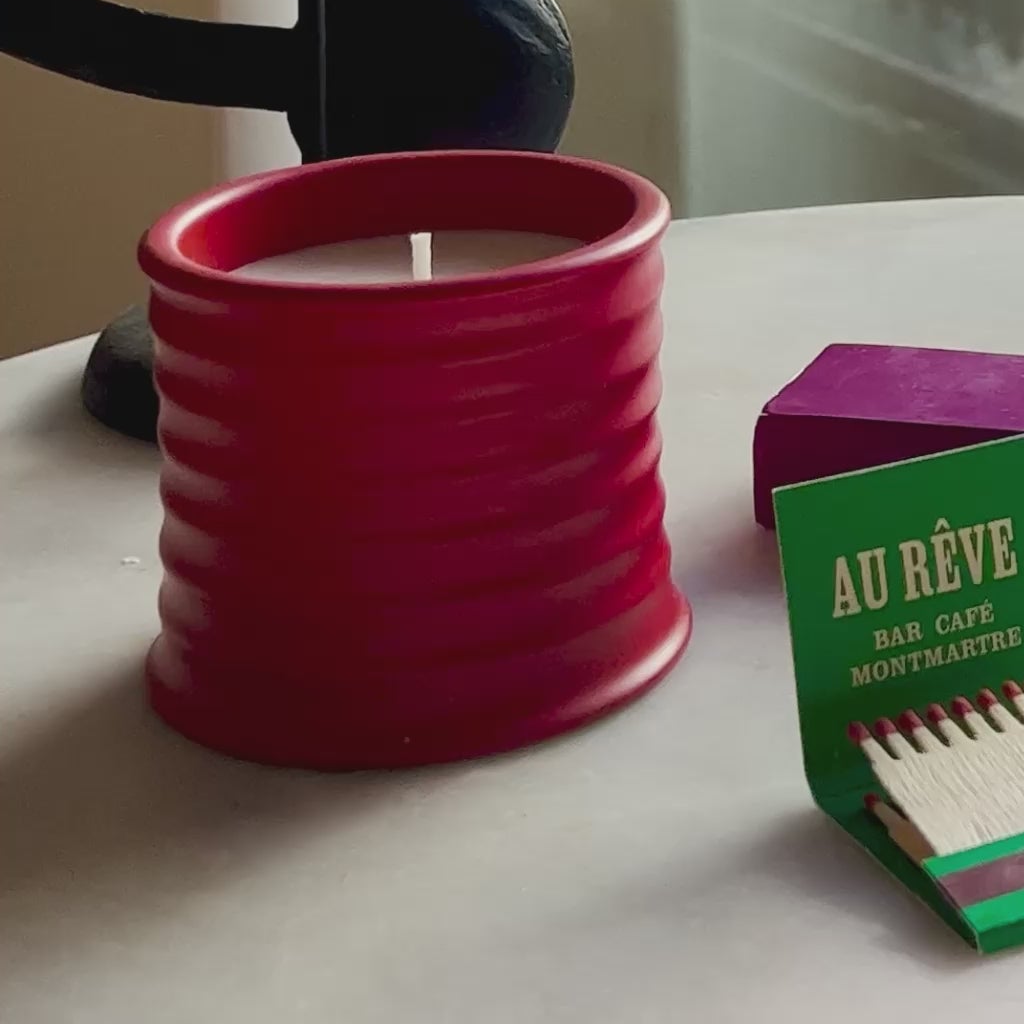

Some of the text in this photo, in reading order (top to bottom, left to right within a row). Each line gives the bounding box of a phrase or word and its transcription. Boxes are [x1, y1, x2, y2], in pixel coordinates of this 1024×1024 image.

[833, 518, 1018, 618] AU RÊVE
[874, 599, 994, 650] BAR CAFÉ
[851, 627, 1022, 687] MONTMARTRE
